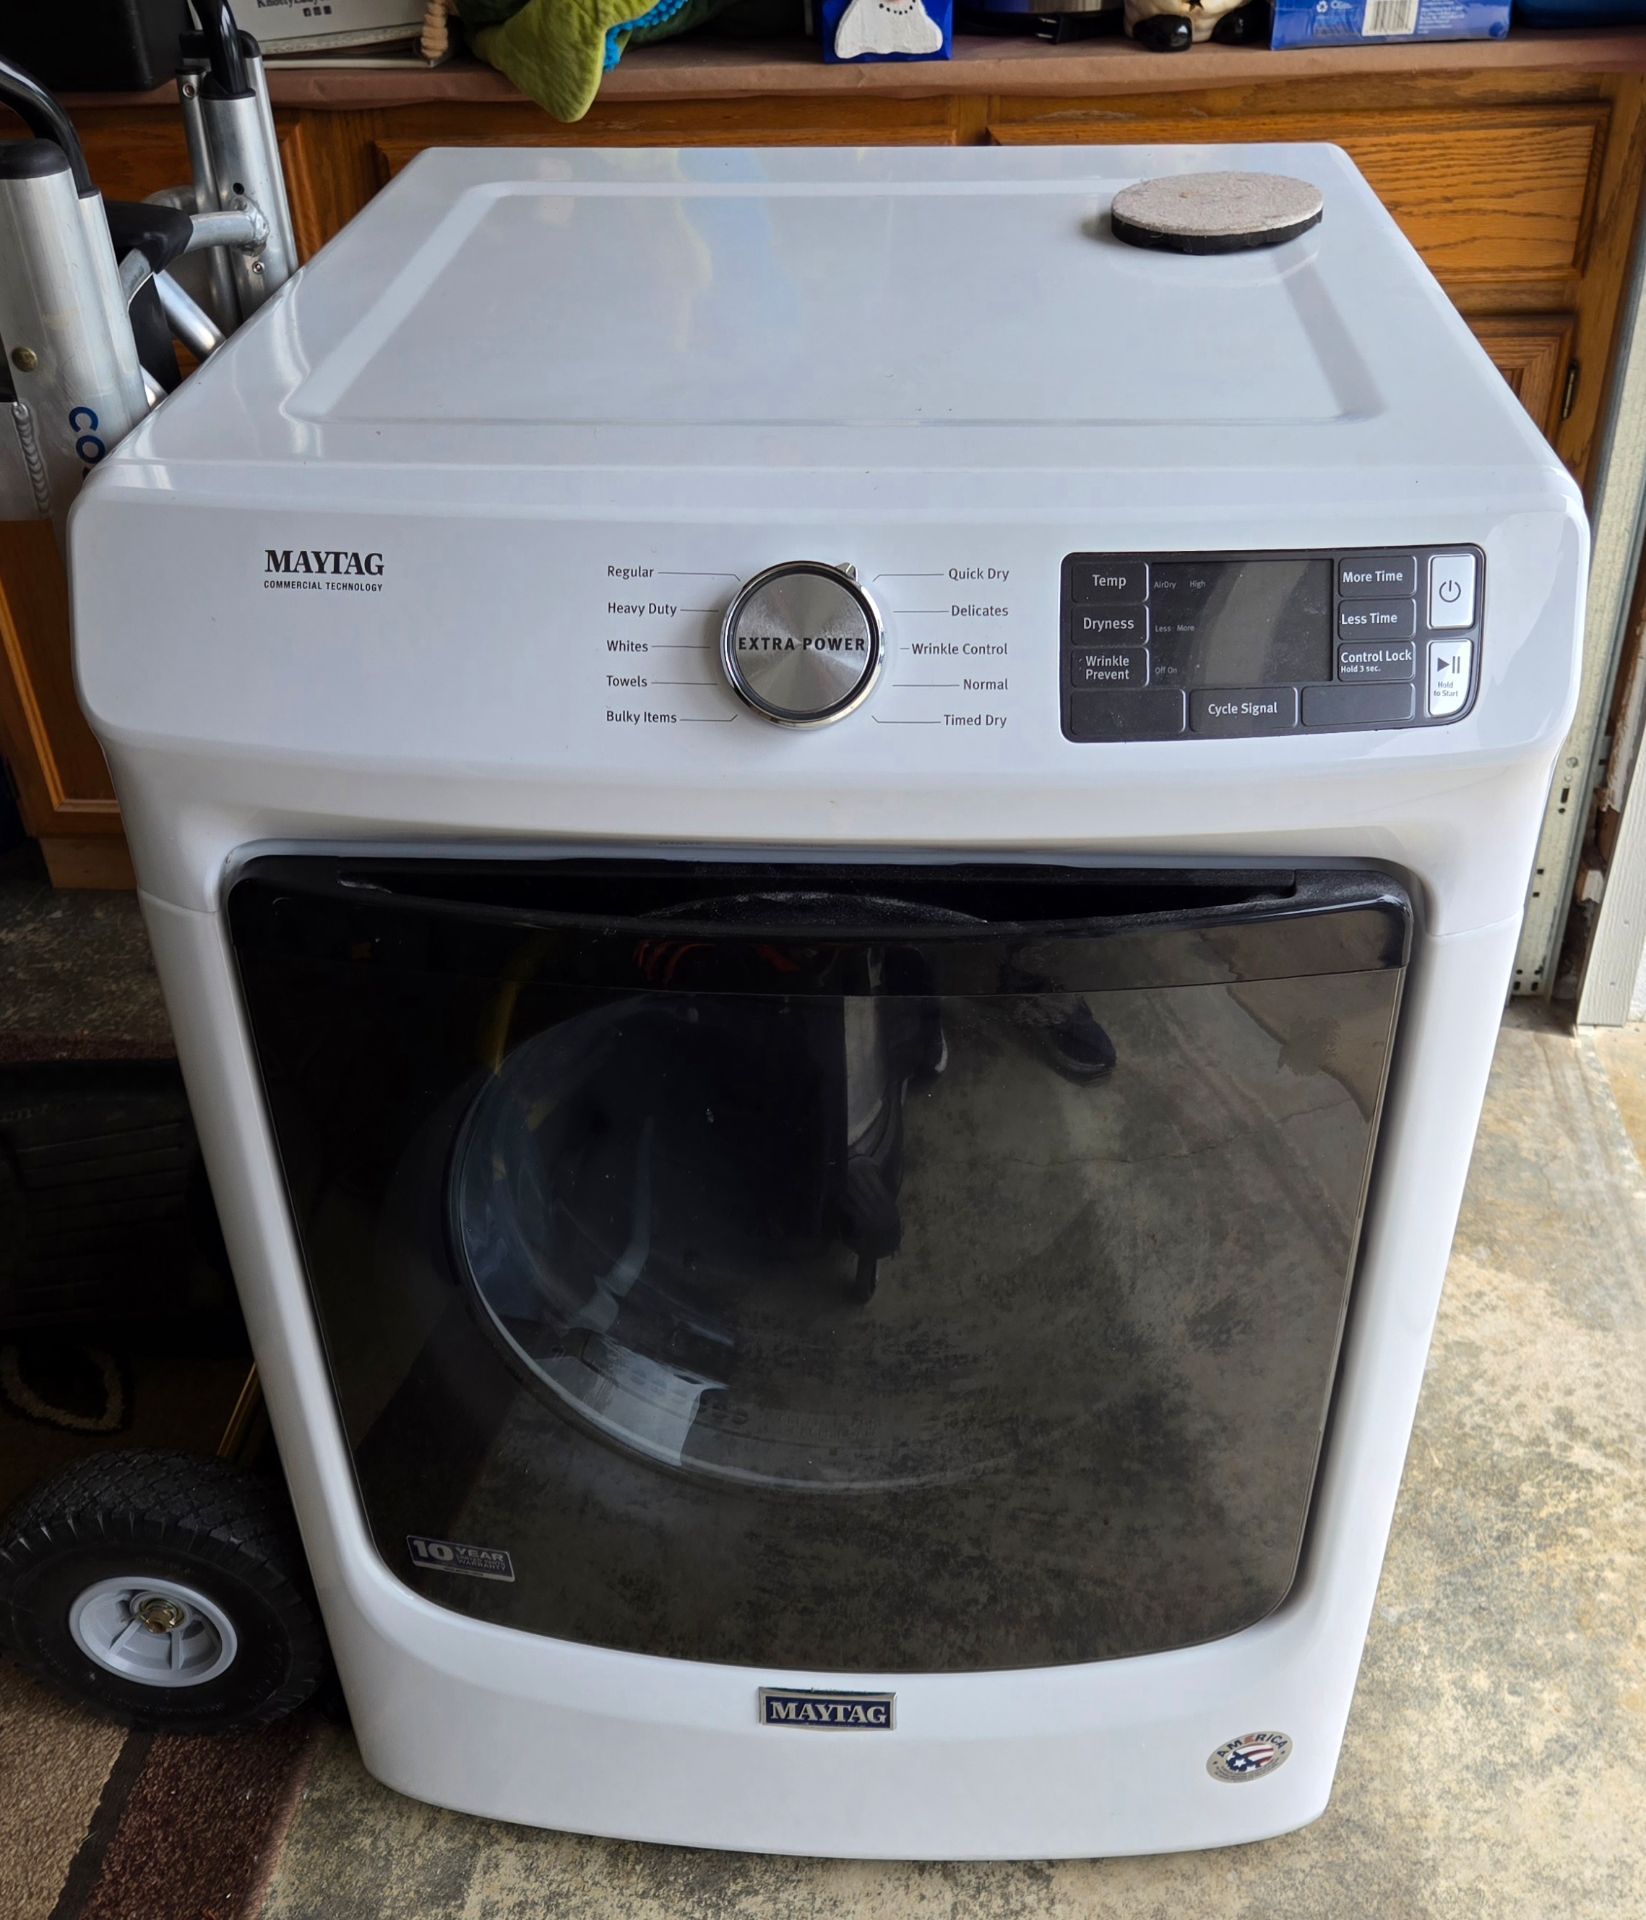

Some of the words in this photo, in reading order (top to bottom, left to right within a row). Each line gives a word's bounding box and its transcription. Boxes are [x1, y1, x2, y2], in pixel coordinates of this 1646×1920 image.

[69, 406, 106, 478] CO
[264, 549, 384, 576] MAYTAG
[607, 565, 654, 579] Regular
[949, 567, 985, 581] Quick
[987, 568, 1010, 582] Dry
[1342, 571, 1373, 583] More
[1374, 570, 1404, 582] Time
[263, 580, 322, 590] COMMERCIAL
[325, 582, 383, 592] TECHNOLOGY
[1092, 574, 1127, 589] Temp
[1189, 580, 1206, 589] High
[607, 602, 645, 616] Heavy
[648, 603, 677, 617] Duty
[951, 605, 1009, 617] Delicates
[1083, 617, 1135, 632] Dryness
[1341, 613, 1368, 625] Less
[1369, 612, 1398, 624] Time
[1176, 624, 1195, 632] More
[606, 640, 649, 652] Whites
[738, 637, 795, 651] EXTRA
[802, 637, 865, 651] POWER
[911, 643, 959, 655] Wrinkle
[962, 643, 1008, 655] Control
[1085, 655, 1130, 667] Wrinkle
[1340, 650, 1383, 663] Control
[1385, 649, 1413, 662] Lock
[1085, 668, 1130, 680] Prevent
[1167, 666, 1178, 674] On
[1340, 665, 1358, 673] Hold
[1359, 665, 1365, 673] 3
[1367, 664, 1381, 672] sec.
[606, 675, 648, 688] Towels
[963, 678, 1009, 691] Normal
[1437, 681, 1454, 689] Hold
[1441, 689, 1459, 697] Start
[1207, 703, 1238, 717] Cycle
[1240, 701, 1278, 716] Signal
[606, 710, 641, 725] Bulky
[643, 711, 678, 724] Items
[943, 714, 982, 727] Timed
[985, 714, 1007, 729] Dry
[413, 1540, 454, 1561] 10
[455, 1547, 504, 1562] YEAR
[770, 1701, 887, 1724] MAYTAG
